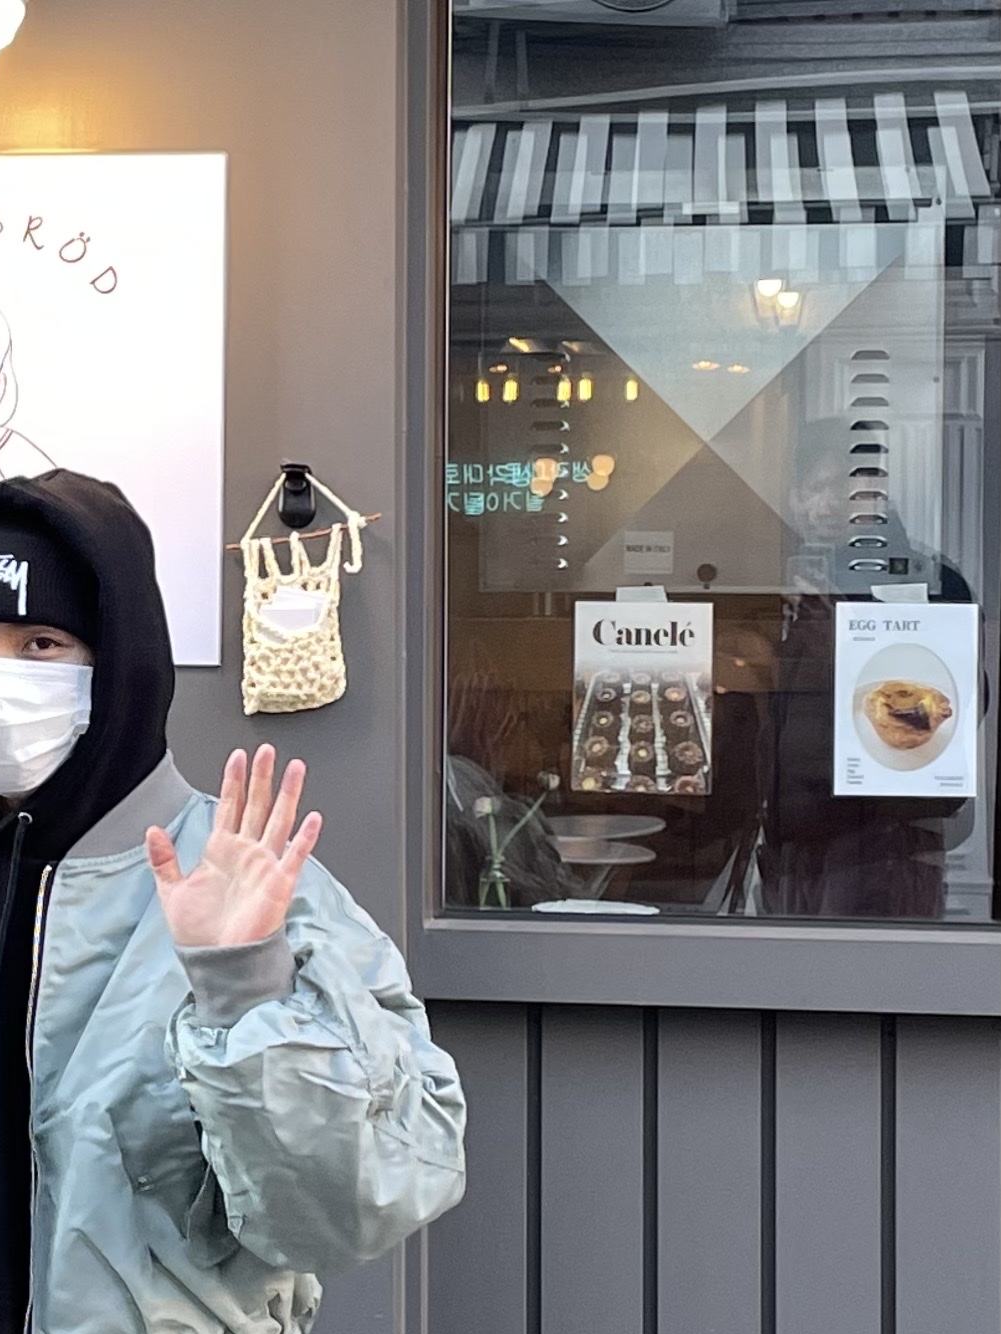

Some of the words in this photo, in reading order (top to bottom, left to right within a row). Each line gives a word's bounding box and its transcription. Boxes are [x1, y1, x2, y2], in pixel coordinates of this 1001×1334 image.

[592, 618, 695, 647] Canelé
[849, 619, 876, 631] EGG
[882, 620, 920, 631] TART
